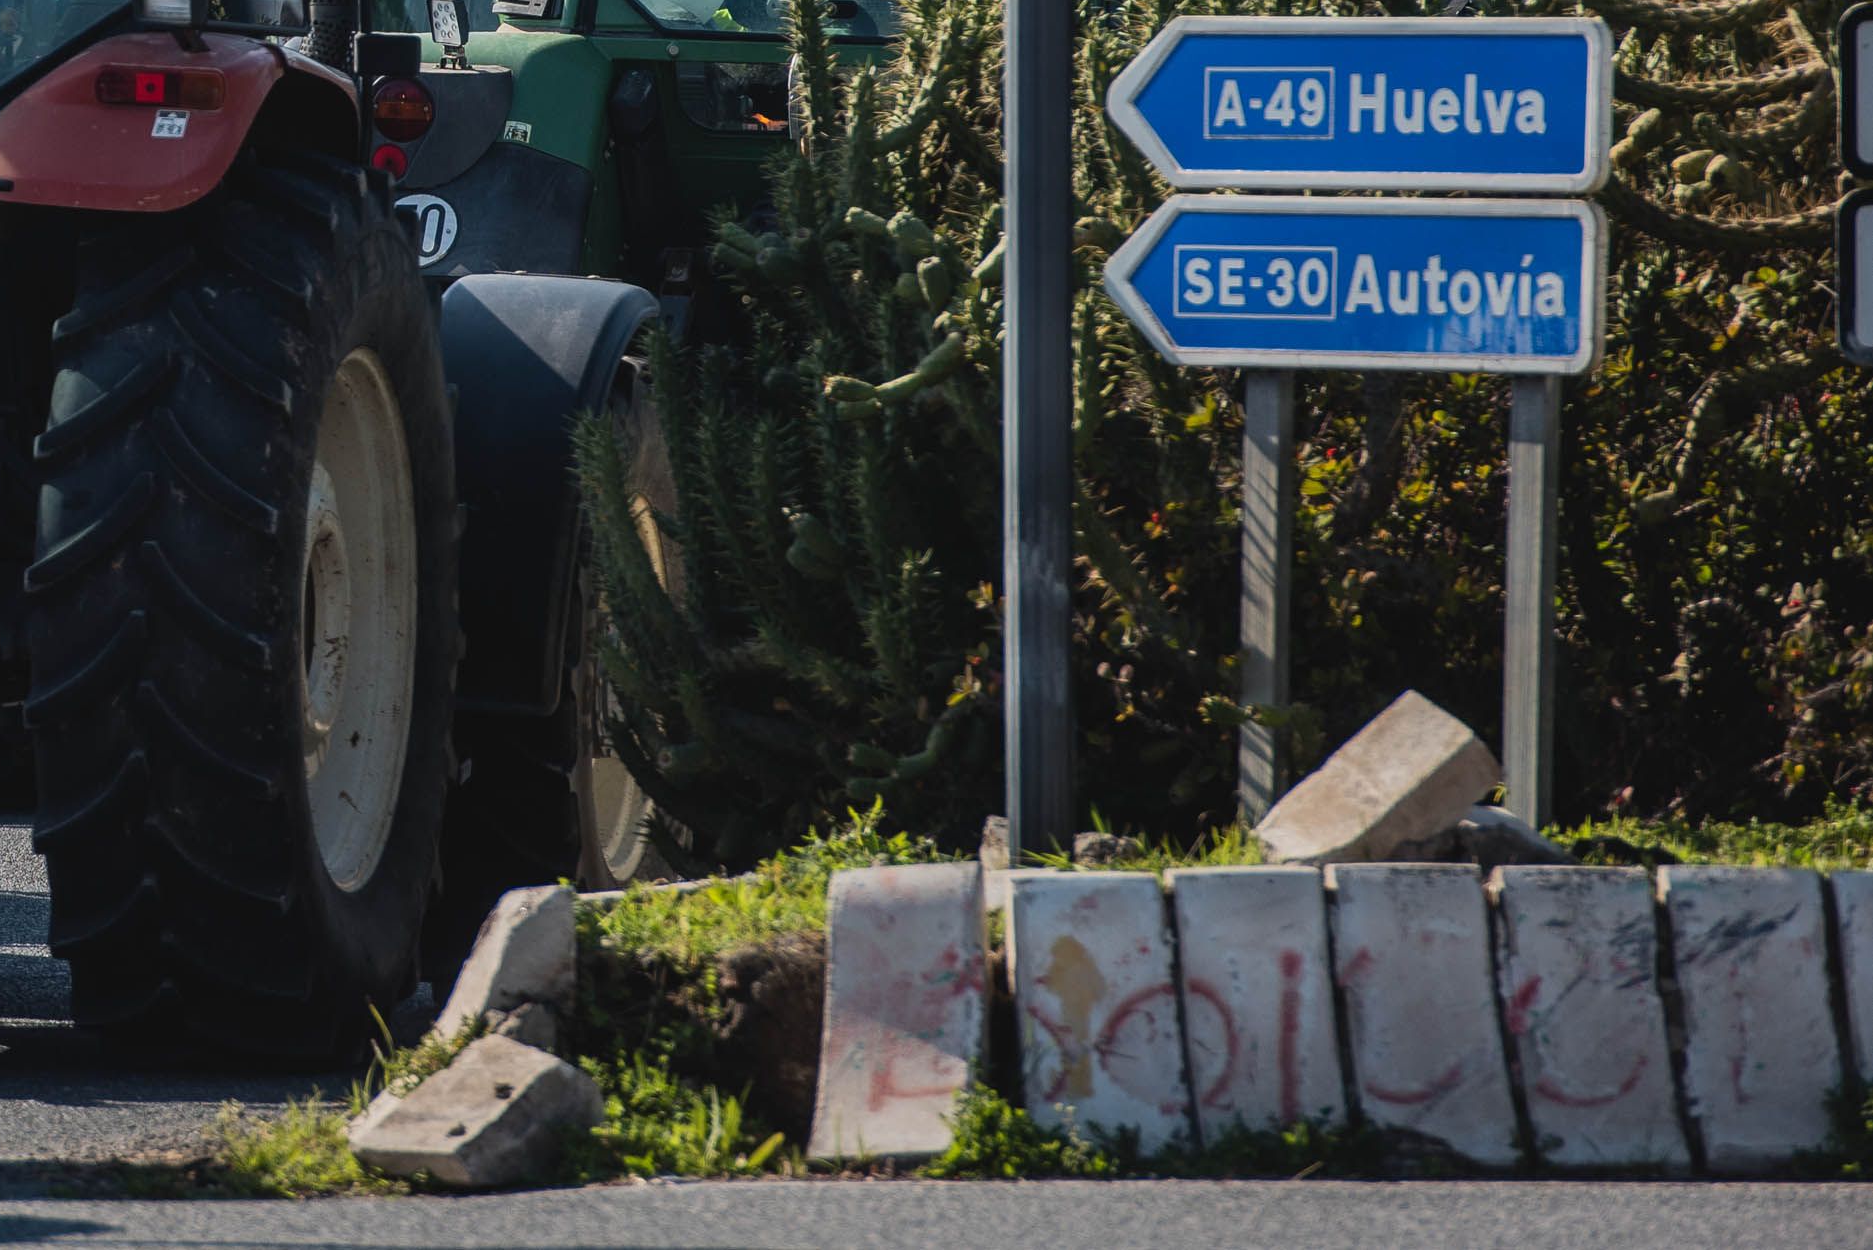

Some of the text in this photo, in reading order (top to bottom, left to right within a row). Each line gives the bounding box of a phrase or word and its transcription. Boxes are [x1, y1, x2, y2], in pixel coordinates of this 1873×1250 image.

[1213, 73, 1547, 134] A-49 Huelva
[1183, 253, 1566, 317] SE-30 Autovía
